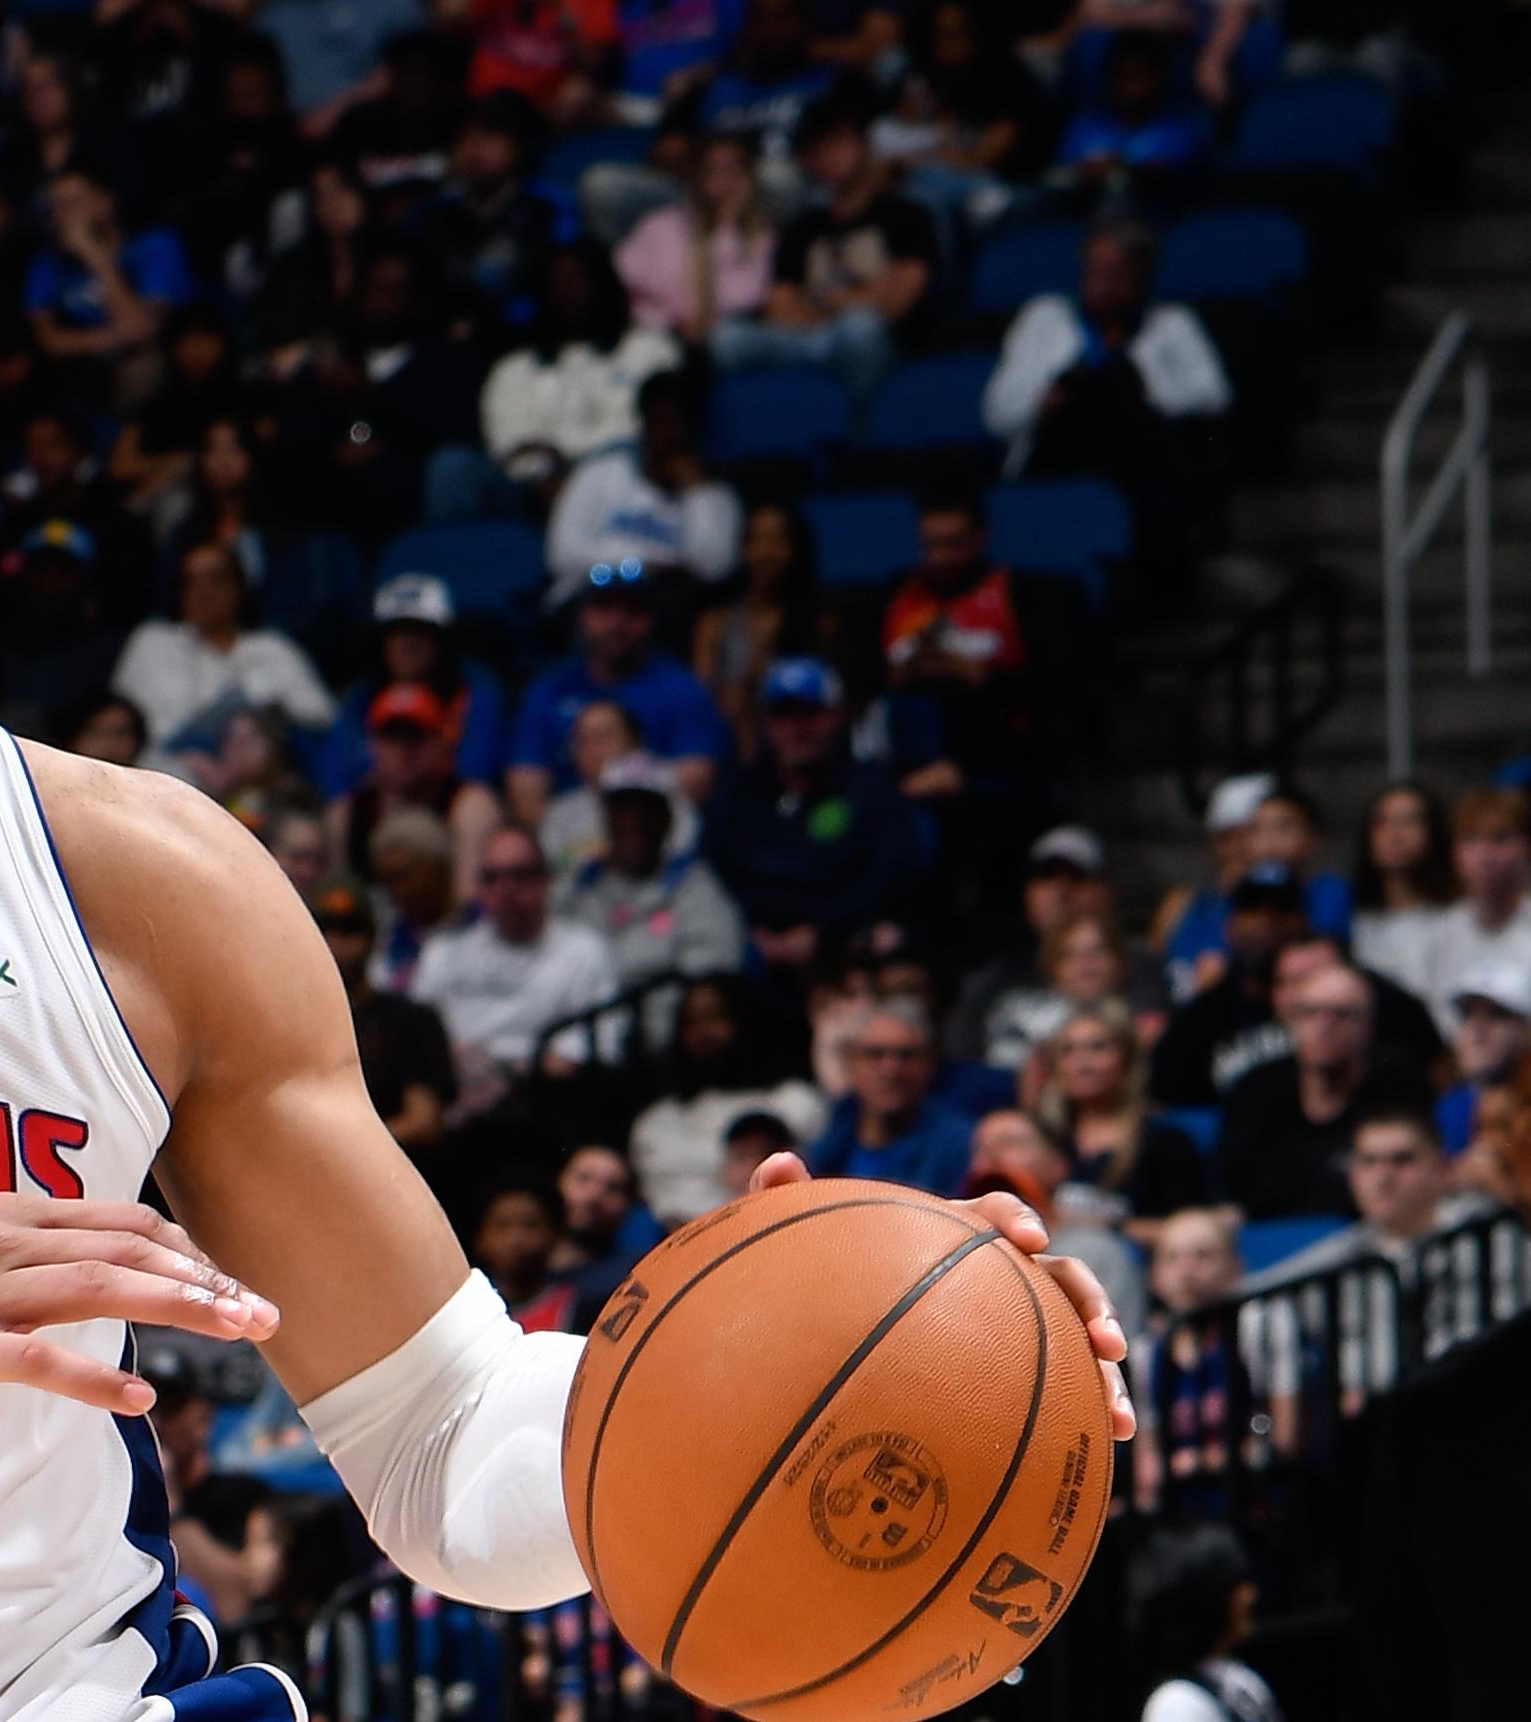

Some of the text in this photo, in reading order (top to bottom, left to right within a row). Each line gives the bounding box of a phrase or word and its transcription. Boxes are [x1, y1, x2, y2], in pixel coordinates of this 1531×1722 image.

[1048, 1433, 1090, 1555] OFFICIAL GAME BALL
